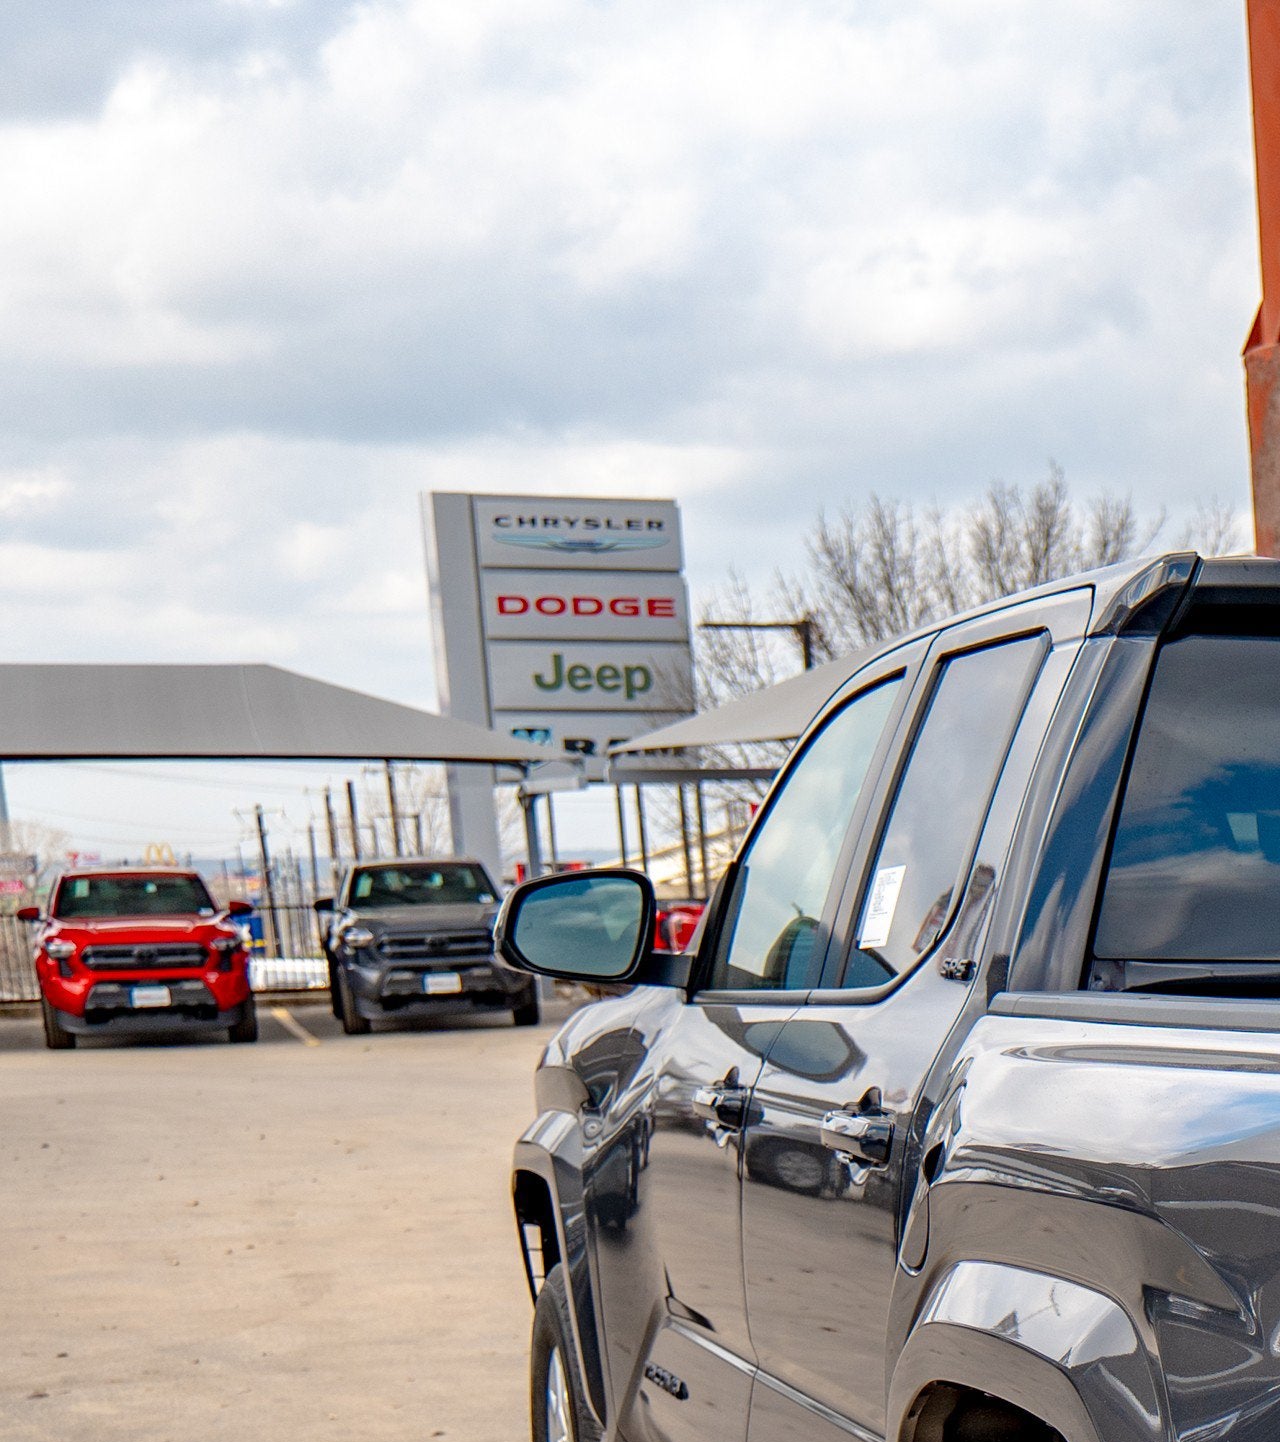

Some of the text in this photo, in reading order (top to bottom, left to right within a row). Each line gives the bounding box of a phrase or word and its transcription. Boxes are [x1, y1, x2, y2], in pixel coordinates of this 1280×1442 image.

[493, 515, 665, 531] CHRYSLER
[496, 595, 676, 617] DODGE
[533, 653, 653, 699] Jeep
